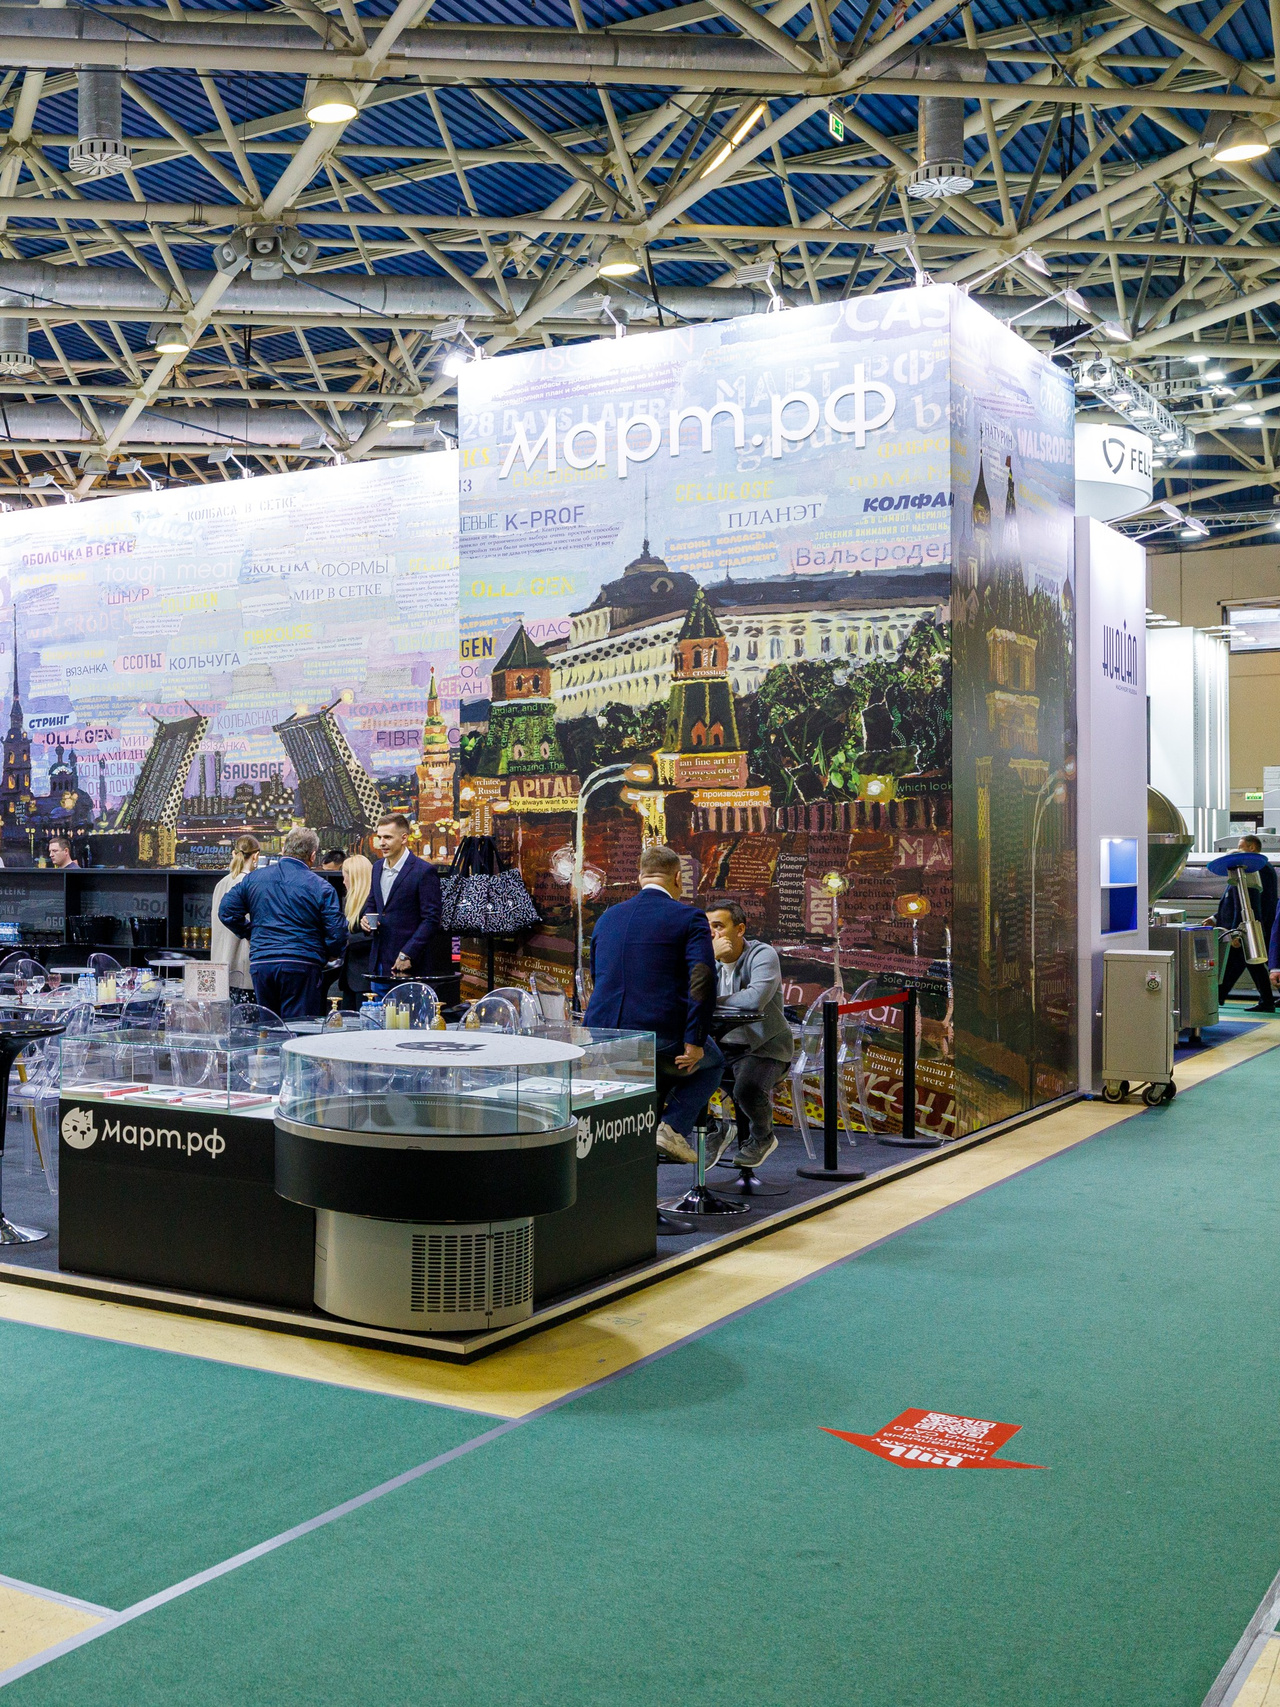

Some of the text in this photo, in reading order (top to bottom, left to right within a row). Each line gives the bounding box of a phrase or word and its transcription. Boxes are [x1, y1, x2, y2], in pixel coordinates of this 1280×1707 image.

[545, 389, 564, 398] план
[463, 412, 494, 439] 28
[499, 362, 897, 479] Март.рф
[985, 423, 1014, 450] НАТУРИН
[676, 480, 774, 502] CELLULOSE
[187, 496, 297, 521] КОЛБАСА В СЕТКЕ
[728, 503, 821, 528] ПЛАНЭТ
[915, 511, 947, 521] МЕРИЛО
[506, 505, 585, 531] K-PROF
[567, 529, 591, 537] простым
[716, 532, 766, 545] КОЛБАСЫ
[855, 525, 910, 538] ВНИМАНИЯ ОТ
[22, 540, 134, 566] ОБОЛОЧКА В СЕТКЕ
[105, 558, 235, 584] tough meat
[321, 560, 389, 578] ФОРМЫ
[680, 562, 714, 572] ФАРШ
[108, 588, 150, 604] ШНУР
[294, 583, 382, 600] МИР В СЕТКЕ
[244, 624, 313, 645] FIBROUSE
[460, 637, 493, 657] GEN
[170, 653, 240, 670] КОЛЬЧУГА
[65, 663, 108, 677] ВЯЗАНКА
[522, 704, 538, 712] and
[29, 715, 69, 729] СТРИНГ
[217, 710, 279, 729] КОЛБАСНАЯ
[42, 730, 114, 745] OLLAGEN
[122, 736, 149, 747] МИР
[200, 741, 247, 751] ВЯЗАНКА
[509, 762, 566, 773] amazing. The
[695, 758, 711, 766] fine
[223, 763, 284, 780] SAUSAGE
[335, 763, 361, 818] ПРОШИВКА
[499, 777, 580, 801] CAPITAL
[702, 790, 760, 798] производстве
[896, 783, 927, 793] which
[522, 799, 543, 807] always
[697, 800, 731, 808] готовые
[810, 884, 833, 940] PORK
[844, 902, 879, 911] look of
[524, 960, 567, 975] Gallery was
[848, 959, 882, 969] царского
[882, 973, 903, 985] Sole
[871, 1061, 892, 1073] time
[923, 1077, 945, 1087] were
[595, 1104, 656, 1143] Март.рф
[101, 1119, 226, 1159] Март.рф
[871, 1438, 986, 1461] LML COMPANY
